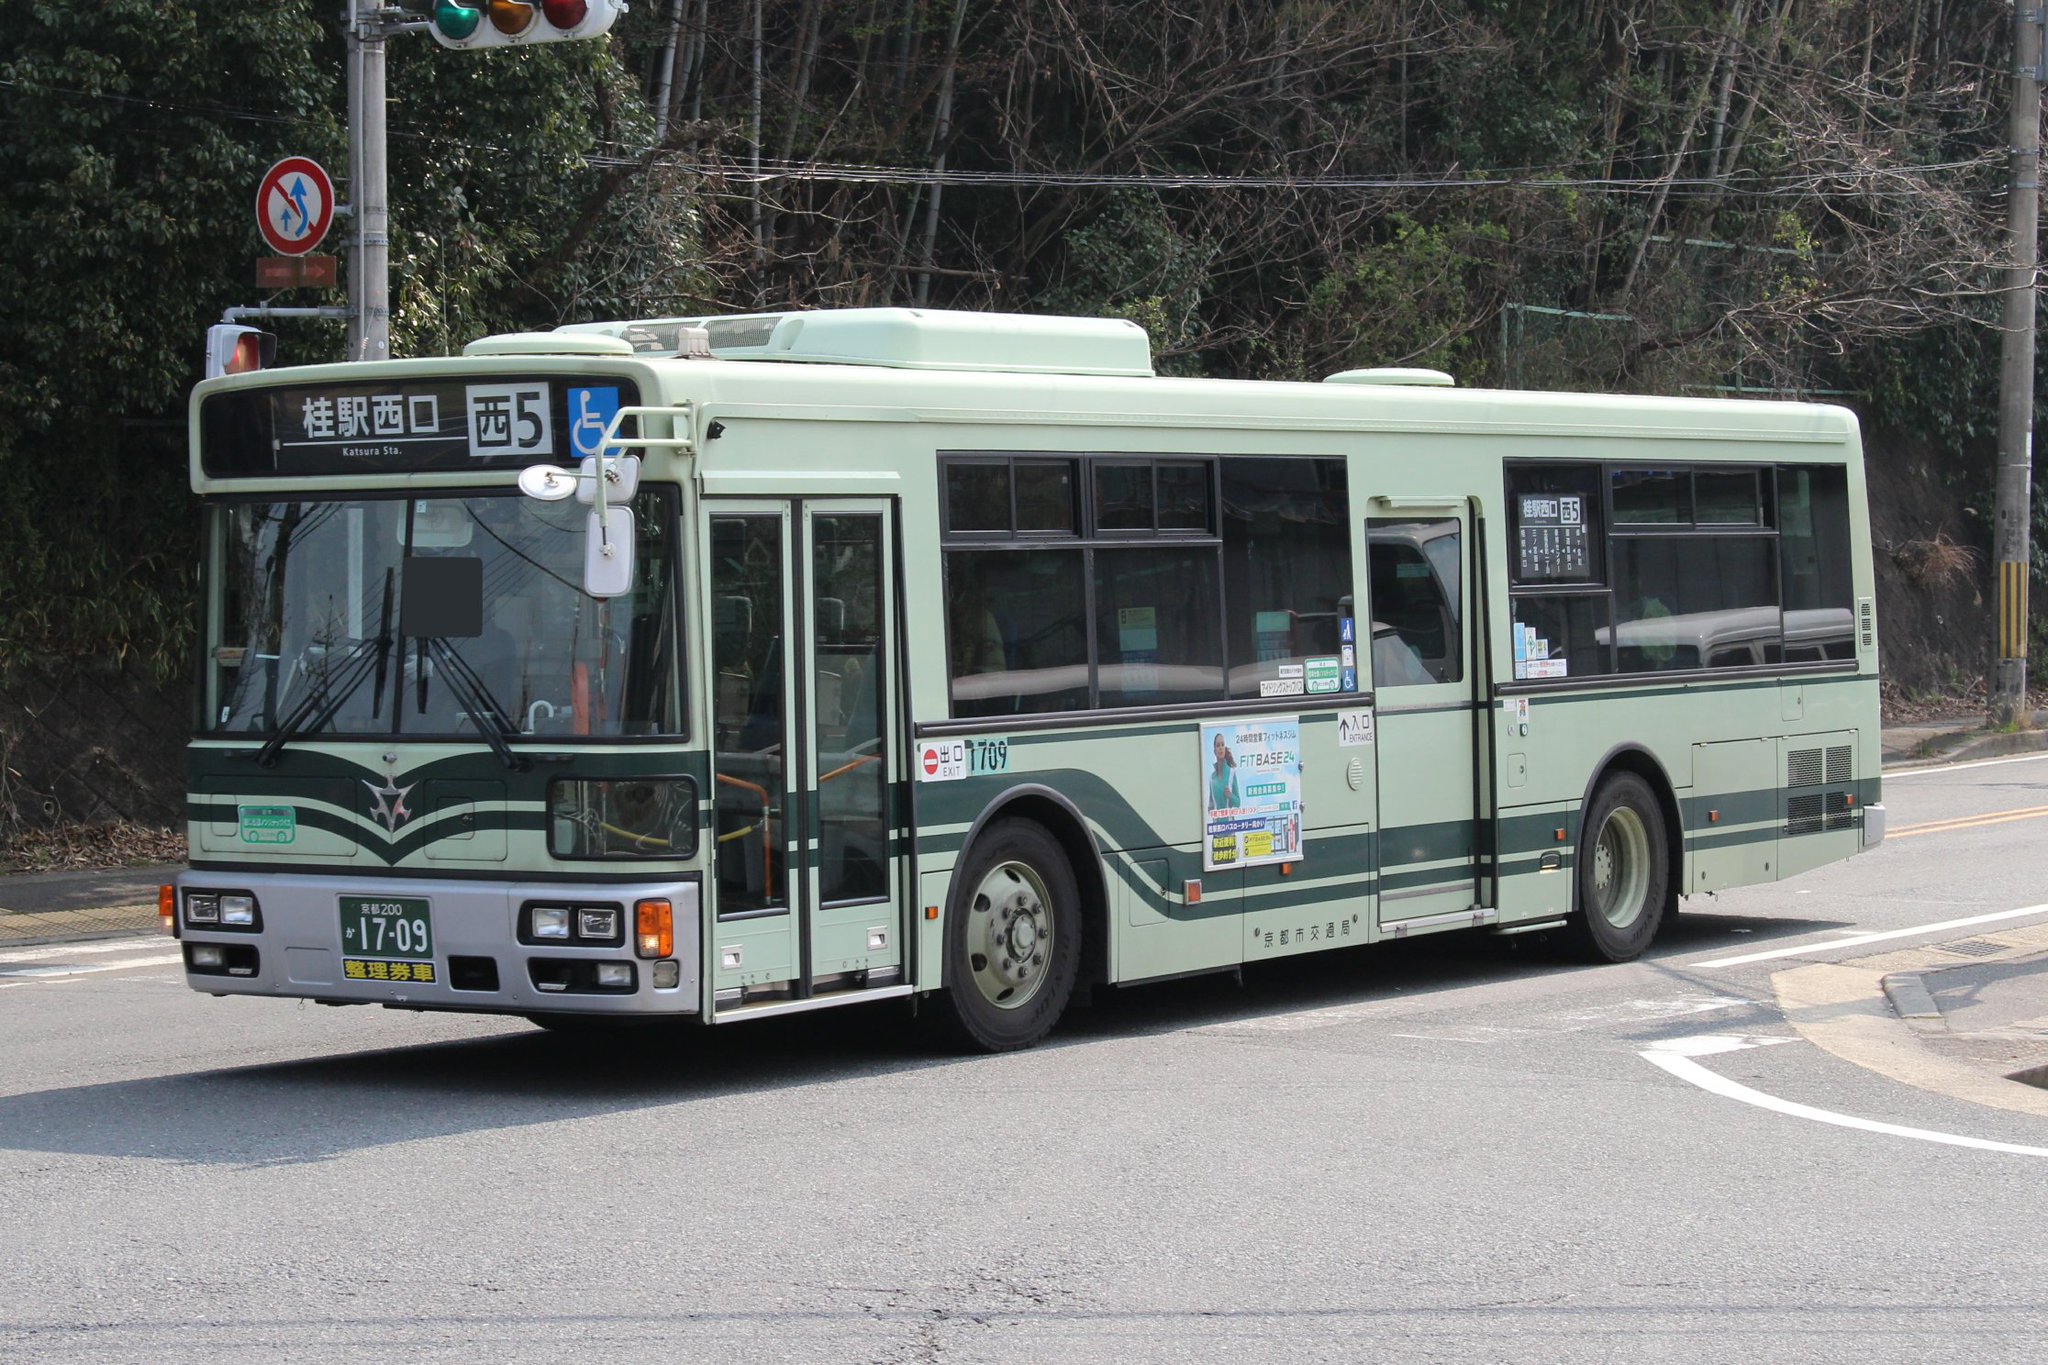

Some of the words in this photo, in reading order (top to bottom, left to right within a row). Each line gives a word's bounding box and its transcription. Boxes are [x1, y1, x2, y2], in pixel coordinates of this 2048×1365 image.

[302, 394, 439, 439] 桂駅西口
[473, 391, 543, 448] 西5
[343, 448, 380, 457] Katsura
[383, 446, 403, 456] Sta.
[1523, 499, 1558, 518] 桂駅西口
[1562, 501, 1579, 521] 西5
[1352, 714, 1370, 730] 入口
[1349, 732, 1373, 743] ENTRANCE
[940, 745, 963, 763] 出口
[970, 740, 1007, 771] 1709
[1240, 751, 1295, 768] FITBASE24
[943, 766, 961, 777] EXIT
[345, 927, 356, 939] か
[360, 916, 428, 953] 17-09
[1264, 920, 1350, 948] 京都市交通局
[345, 960, 434, 982] 整理券車
